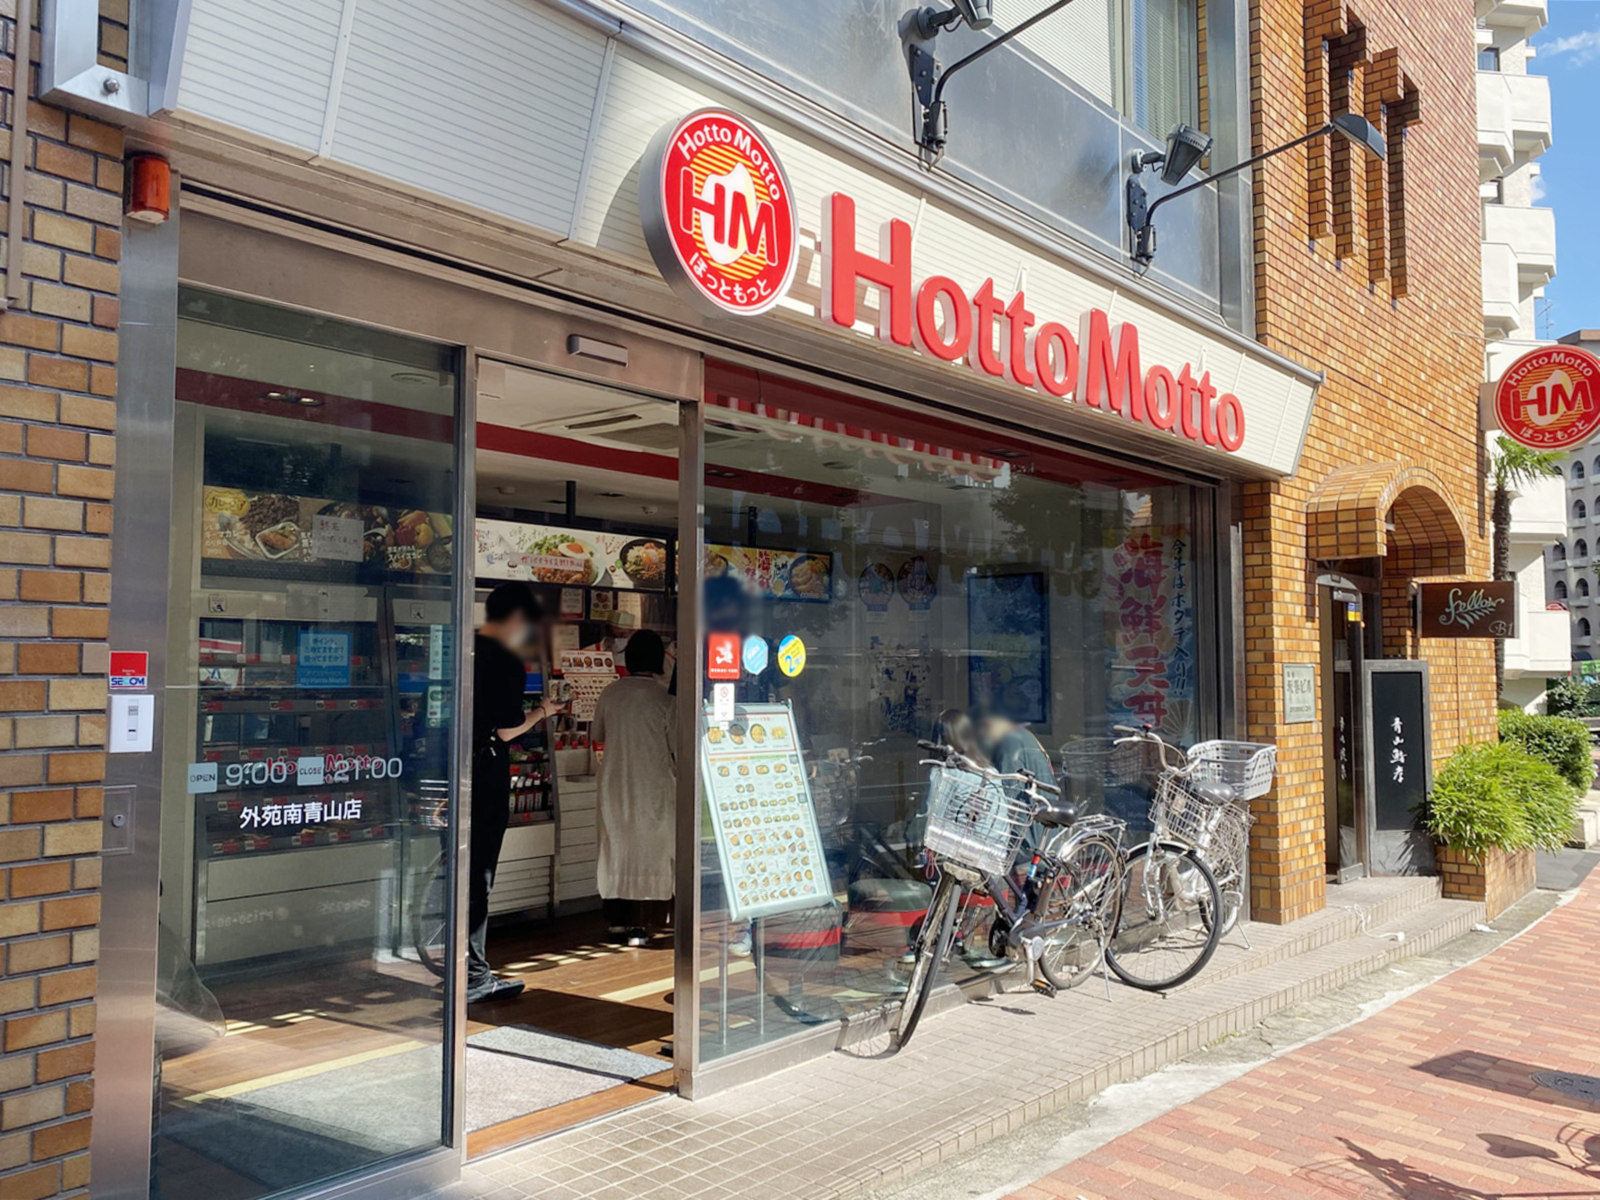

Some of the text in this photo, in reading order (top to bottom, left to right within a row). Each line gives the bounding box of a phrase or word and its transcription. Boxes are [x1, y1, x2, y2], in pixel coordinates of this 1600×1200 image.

[679, 166, 778, 267] HM
[689, 252, 772, 304] ほっともっと
[1510, 378, 1594, 421] HM
[1520, 419, 1589, 442] ほっともっと
[1105, 533, 1171, 727] 海鮮天丼
[111, 677, 145, 686] SECOM
[190, 773, 216, 783] OPEN
[299, 766, 321, 775] CLOSE
[333, 757, 403, 782] 21:00
[239, 799, 363, 829] 外苑南青山店
